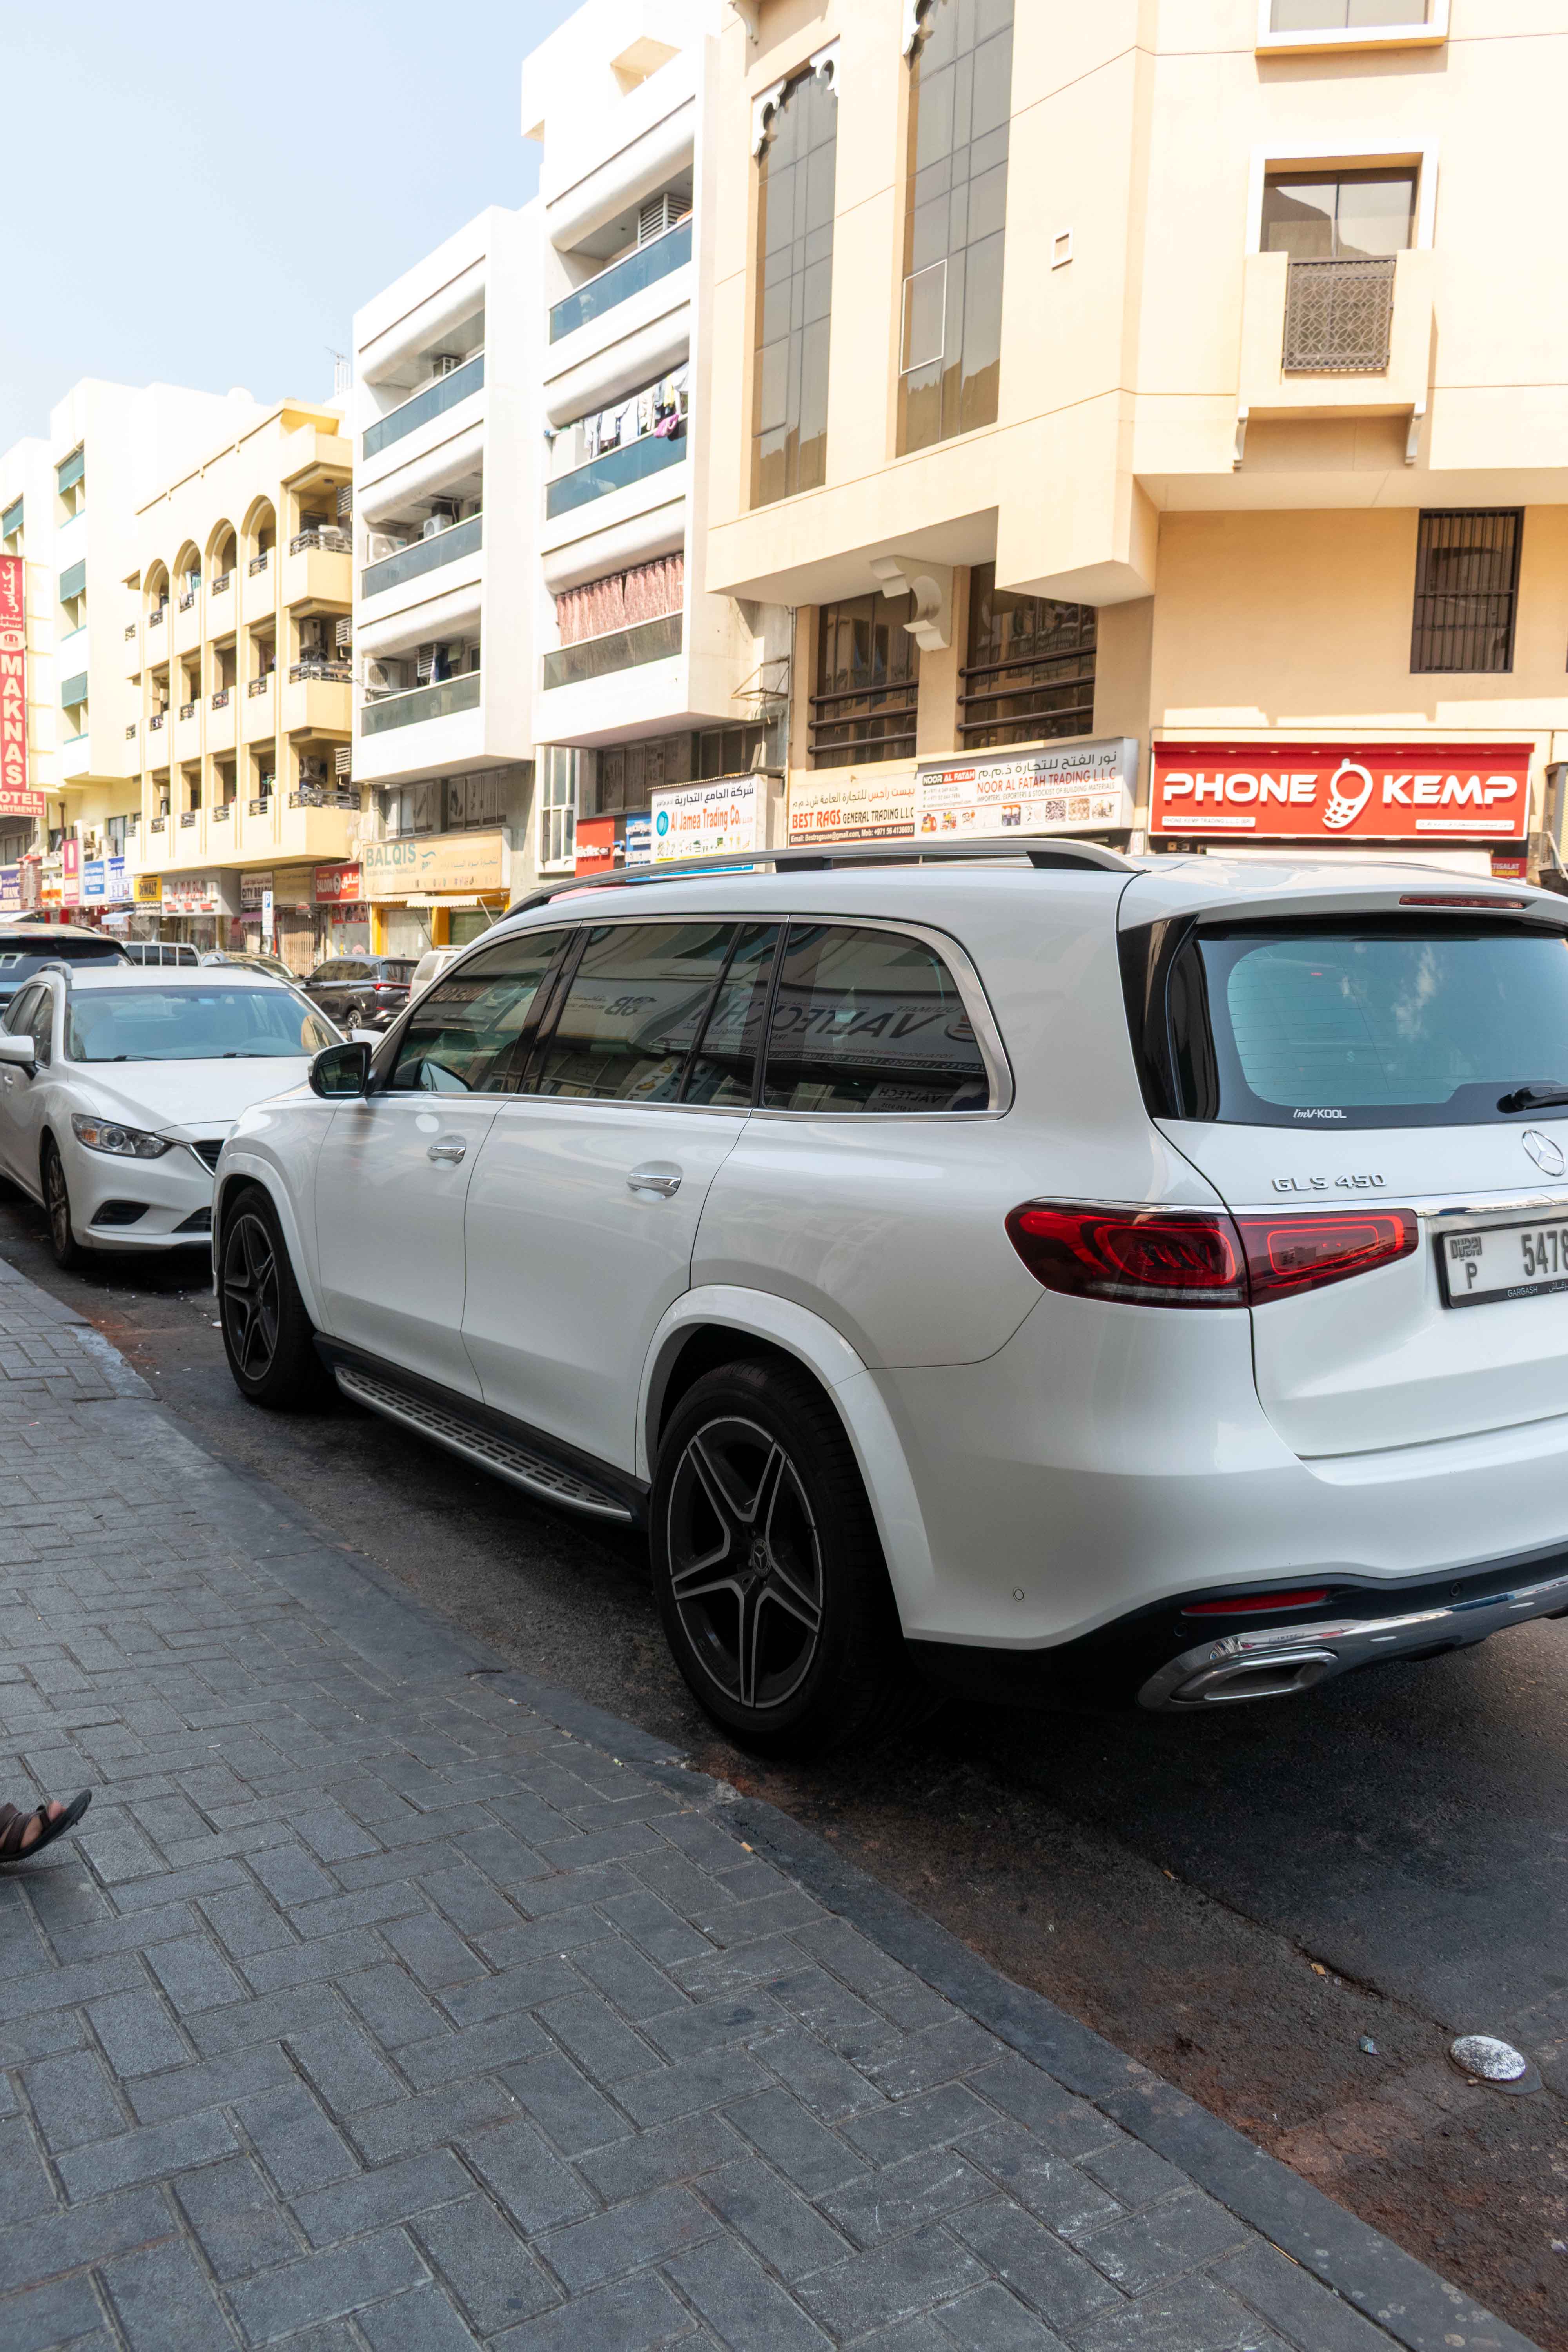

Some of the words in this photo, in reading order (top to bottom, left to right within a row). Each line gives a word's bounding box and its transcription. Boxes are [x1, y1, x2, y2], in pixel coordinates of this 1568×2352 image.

[1, 653, 24, 785] MAKNAS
[1016, 758, 1058, 775] للتجارة
[1061, 753, 1094, 769] الفتح
[1099, 751, 1117, 766] نور
[923, 775, 943, 784] NOOR
[943, 774, 953, 782] AL
[954, 771, 975, 781] FATAH
[977, 780, 1003, 794] NOOR
[1005, 779, 1016, 791] AL
[1019, 775, 1046, 789] FATAH
[1049, 770, 1091, 785] TRADING
[1093, 766, 1116, 782] L.L.C
[704, 788, 729, 804] الجامع
[731, 782, 754, 799] شركة
[868, 787, 890, 802] راجس
[892, 787, 915, 797] بيست
[1003, 792, 1027, 800] EXPORTERS
[1033, 789, 1055, 797] STOCKIST
[1064, 785, 1087, 794] BUILDING
[1089, 782, 1115, 792] MATERIALS
[1163, 773, 1318, 803] PHONE
[1382, 775, 1517, 804] KEMP
[0, 791, 43, 805] OTEL
[674, 792, 702, 807] التجارية
[820, 791, 841, 804] العامة
[842, 789, 867, 805] للتجارة
[671, 811, 679, 832] Al
[679, 810, 701, 830] Jamea
[702, 806, 728, 832] Trading
[730, 804, 742, 825] Co.
[792, 812, 814, 829] BEST
[817, 809, 841, 828] RAGS
[843, 811, 869, 824] GENERAL
[871, 808, 898, 822] TRADING
[861, 829, 873, 837] Mob:
[873, 827, 885, 836] +971
[367, 843, 416, 867] BALQIS
[242, 887, 253, 899] CITY
[316, 878, 333, 893] SALOON
[1272, 1176, 1329, 1192] GLS
[1335, 1173, 1388, 1189] 450
[1465, 1262, 1477, 1289] P
[1507, 1285, 1538, 1298] GARGASH
